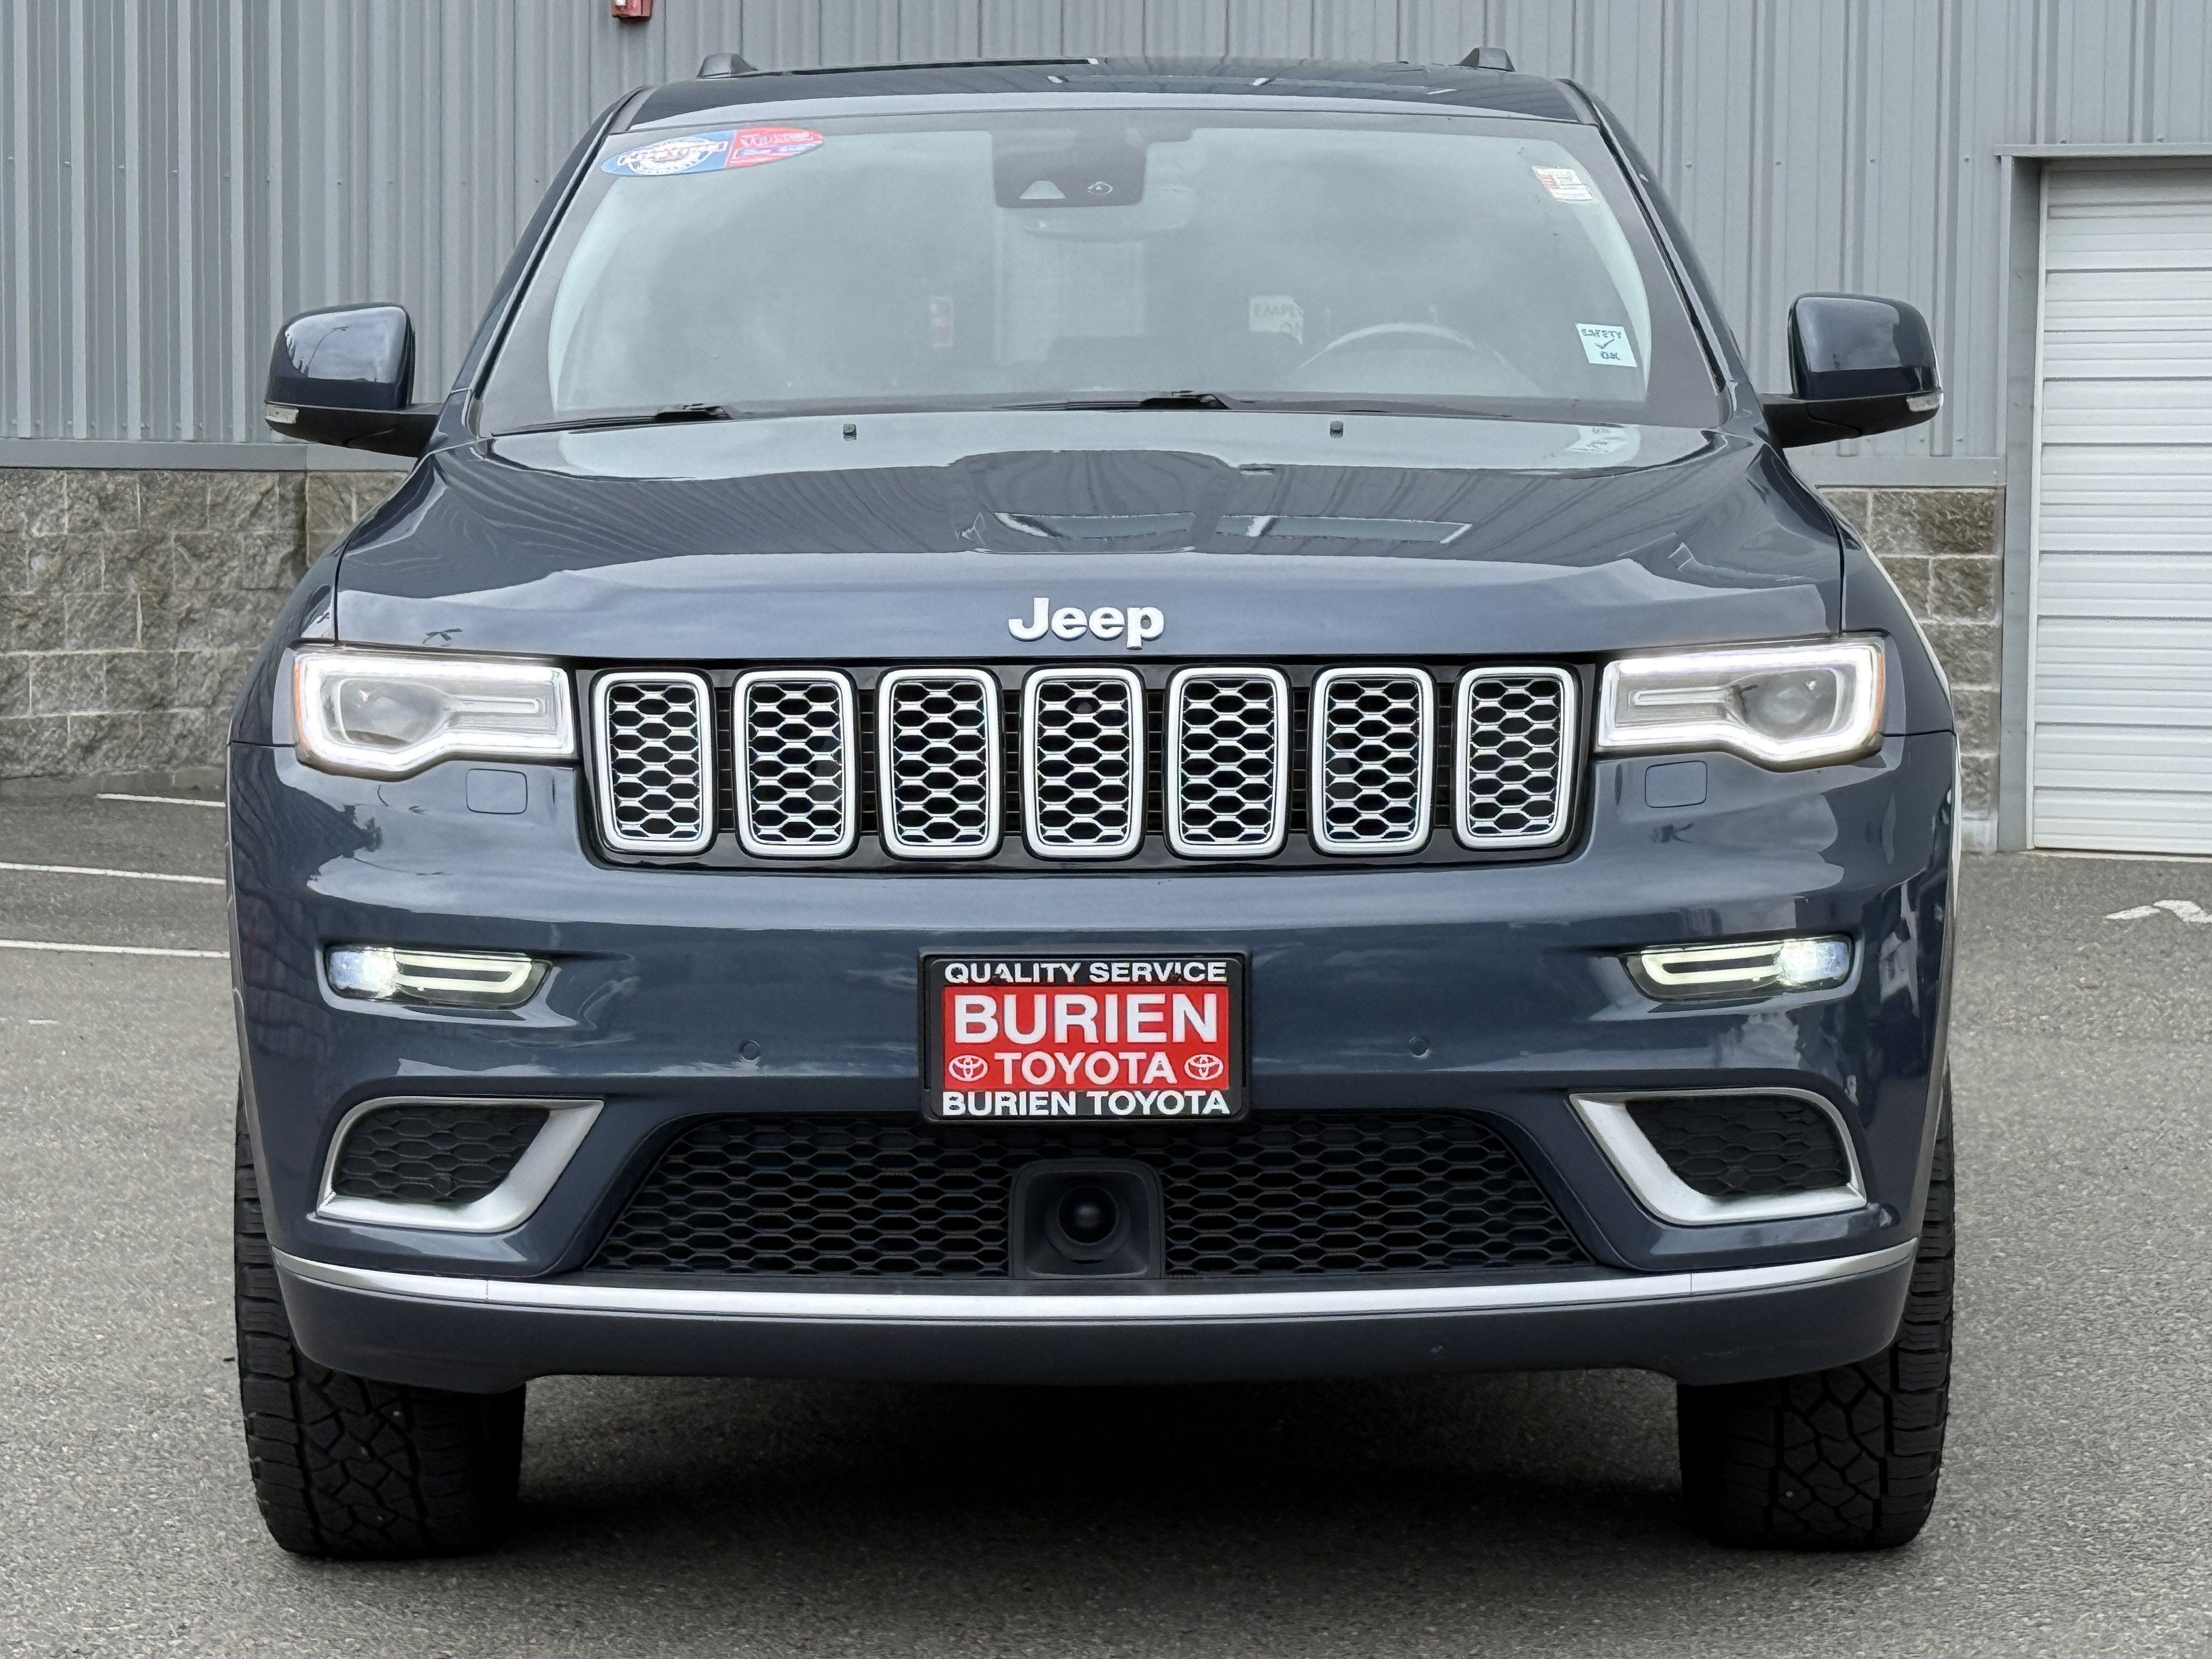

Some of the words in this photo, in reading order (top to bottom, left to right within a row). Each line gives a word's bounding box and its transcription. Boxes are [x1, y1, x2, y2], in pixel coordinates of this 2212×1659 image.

[1008, 597, 1164, 650] Jeep
[944, 962, 1081, 984] QUALITY
[1089, 961, 1227, 983] SERVICE
[953, 993, 1217, 1044] BURIEN
[994, 1051, 1178, 1085] TOYOTA
[942, 1091, 1076, 1116] BURIEN
[1086, 1090, 1231, 1115] TOYOTA
